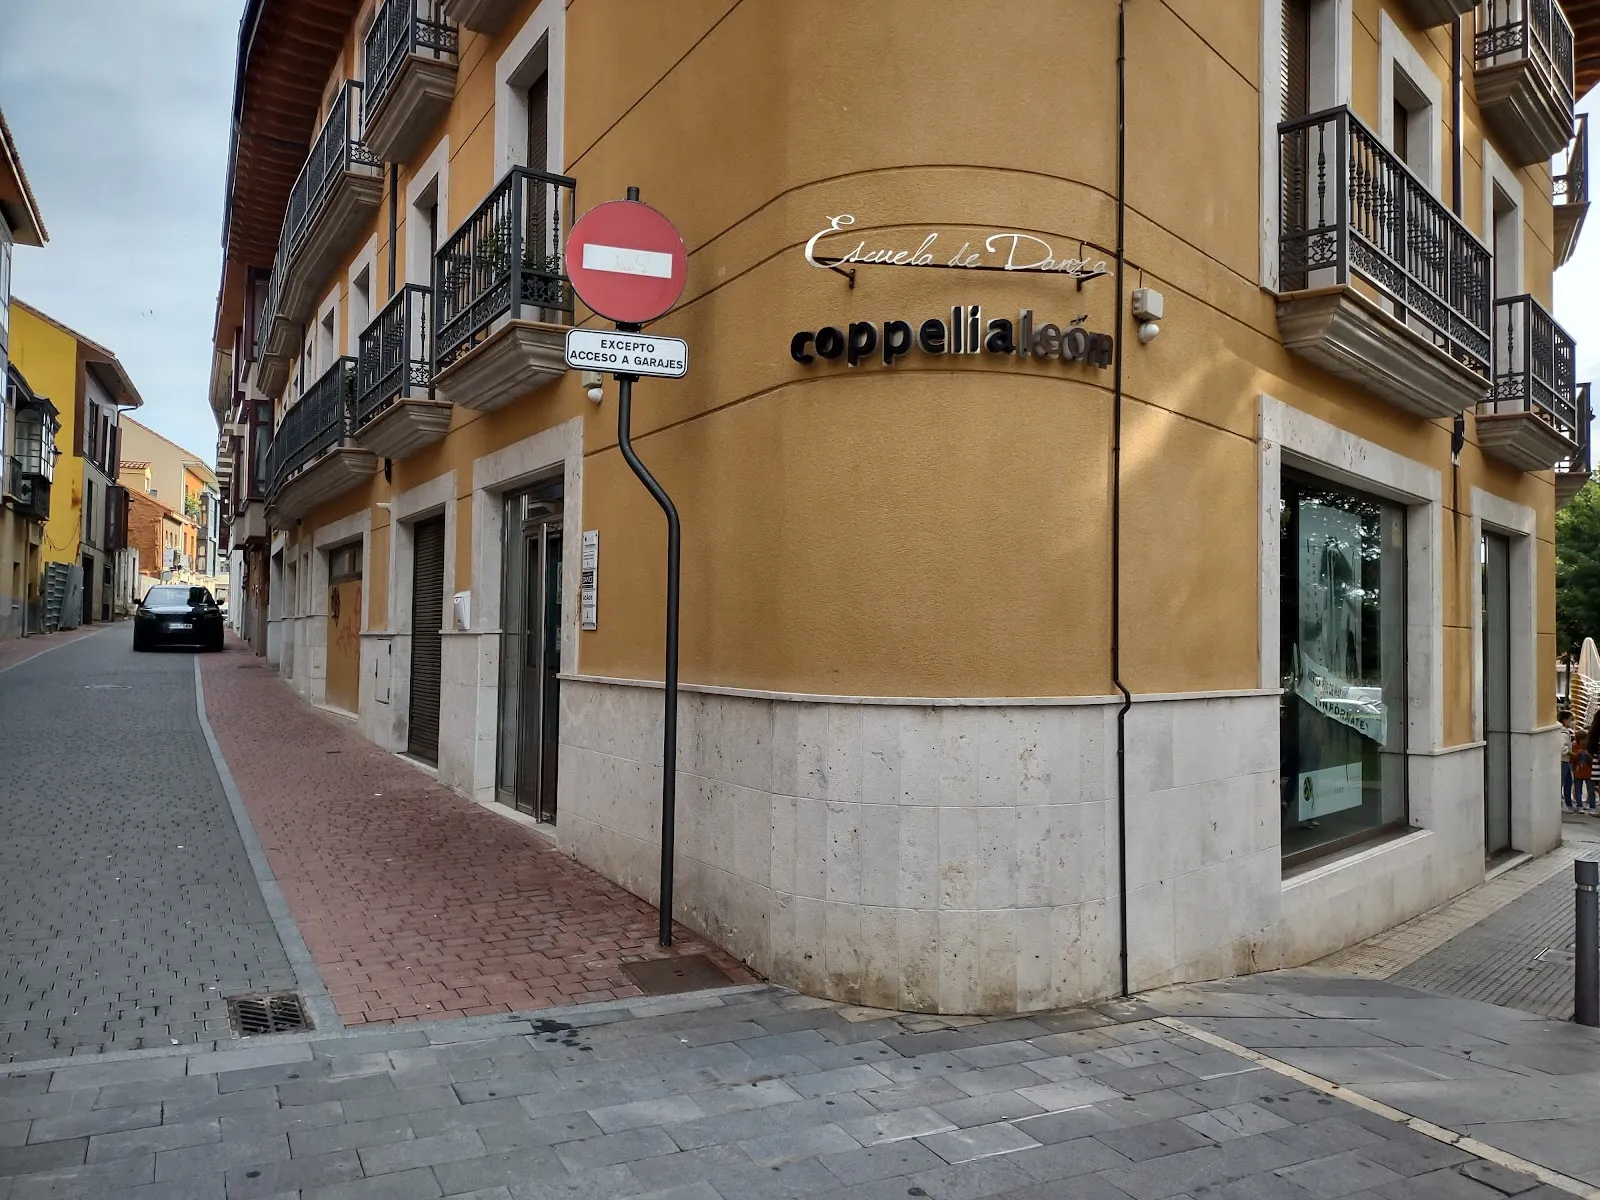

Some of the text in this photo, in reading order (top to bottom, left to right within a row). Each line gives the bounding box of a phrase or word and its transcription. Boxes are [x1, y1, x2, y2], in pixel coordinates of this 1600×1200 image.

[804, 214, 1114, 279] Escuela de Danza
[600, 339, 655, 353] EXCEPTO
[570, 350, 683, 370] ACCESO A GARAJES
